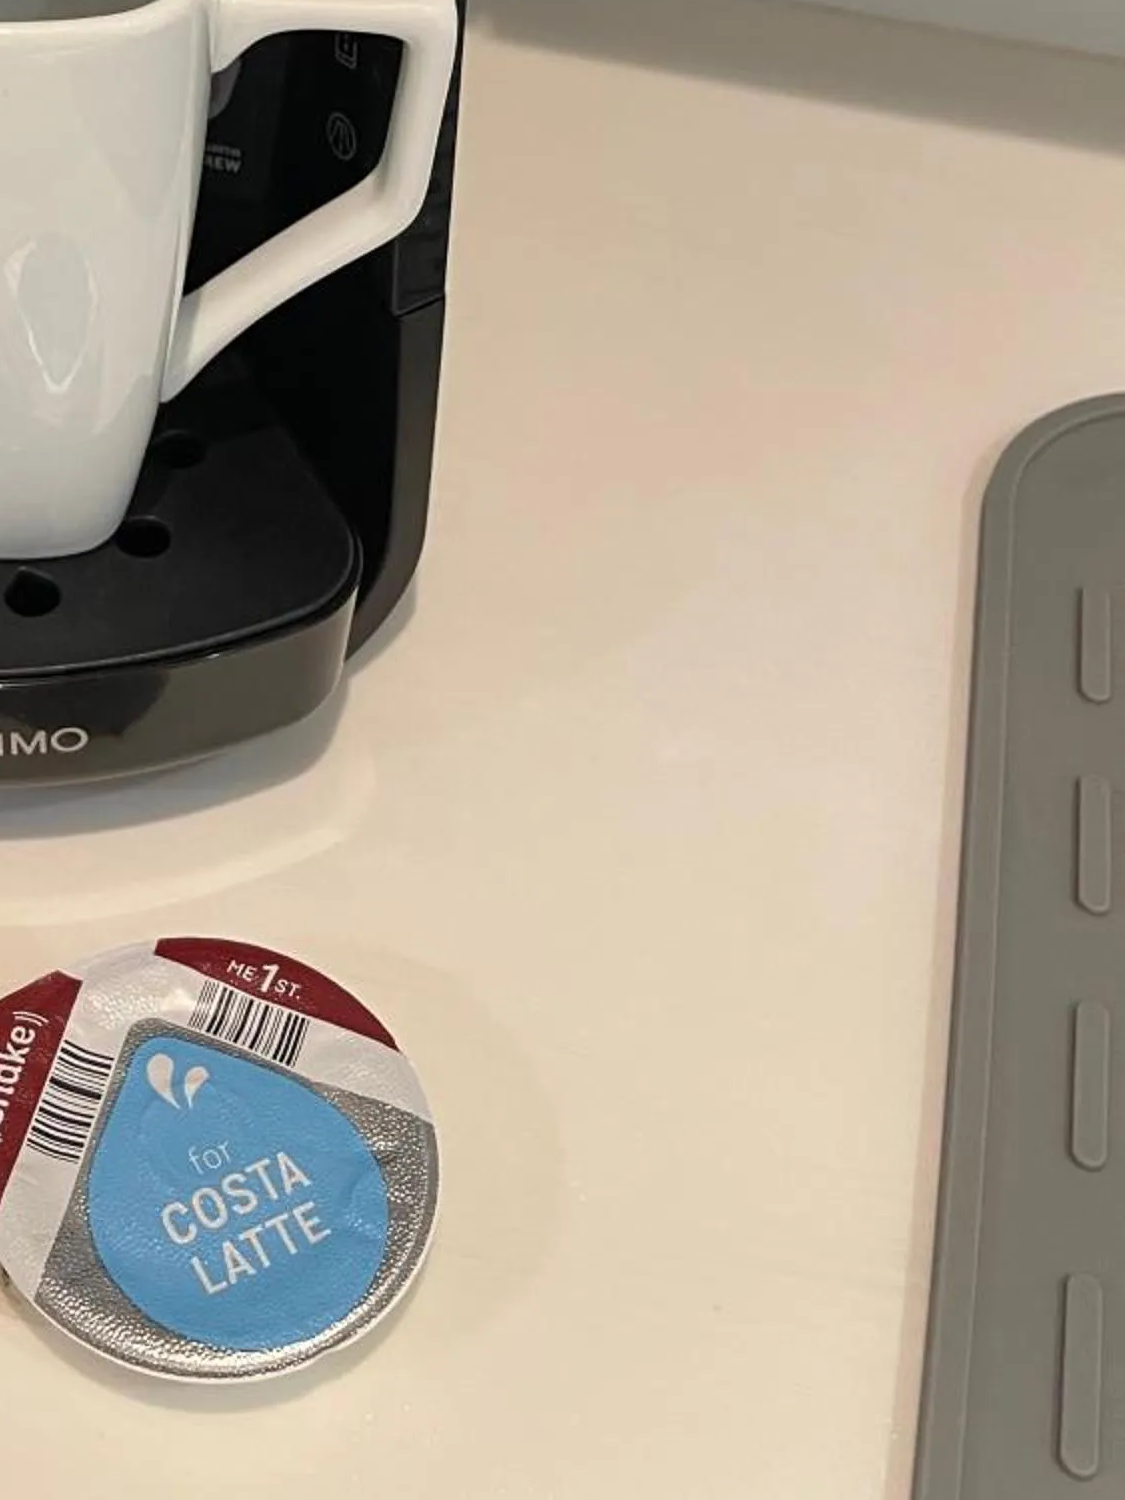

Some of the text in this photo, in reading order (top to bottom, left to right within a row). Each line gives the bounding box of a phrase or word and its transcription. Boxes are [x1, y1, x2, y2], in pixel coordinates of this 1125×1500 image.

[226, 959, 258, 983] ME
[187, 1140, 236, 1178] for
[159, 1150, 313, 1247] COSTA
[189, 1200, 333, 1297] LATTE
